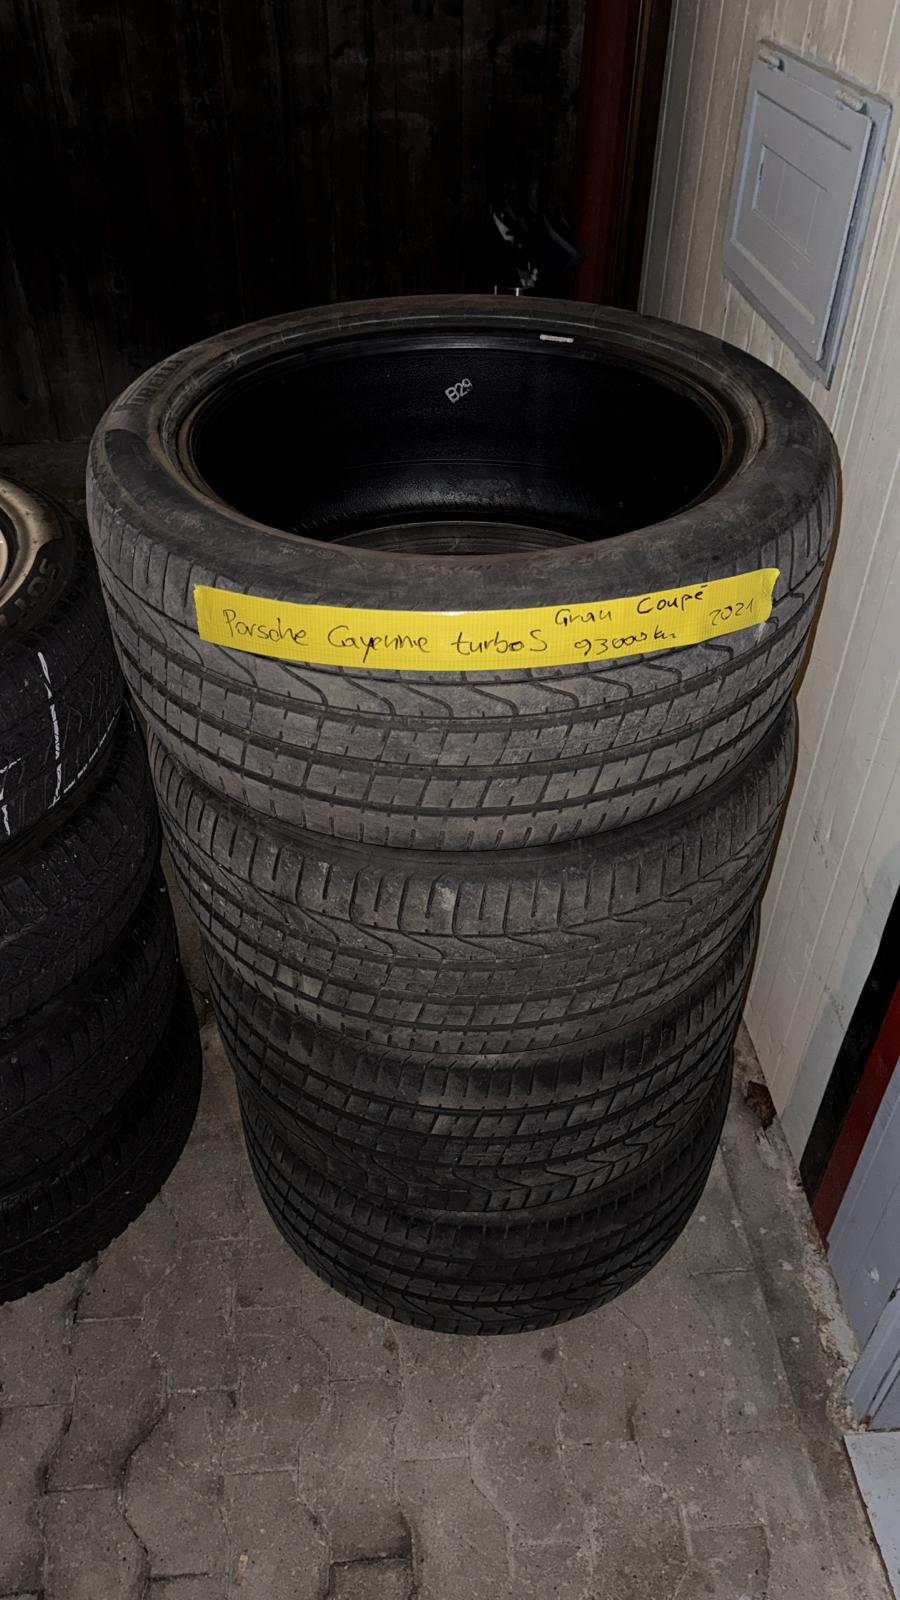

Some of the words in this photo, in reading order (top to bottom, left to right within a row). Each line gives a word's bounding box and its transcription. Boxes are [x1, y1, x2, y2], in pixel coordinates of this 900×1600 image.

[222, 608, 309, 647] Porsche
[327, 624, 431, 663] Cayenne
[708, 597, 754, 627] 2021
